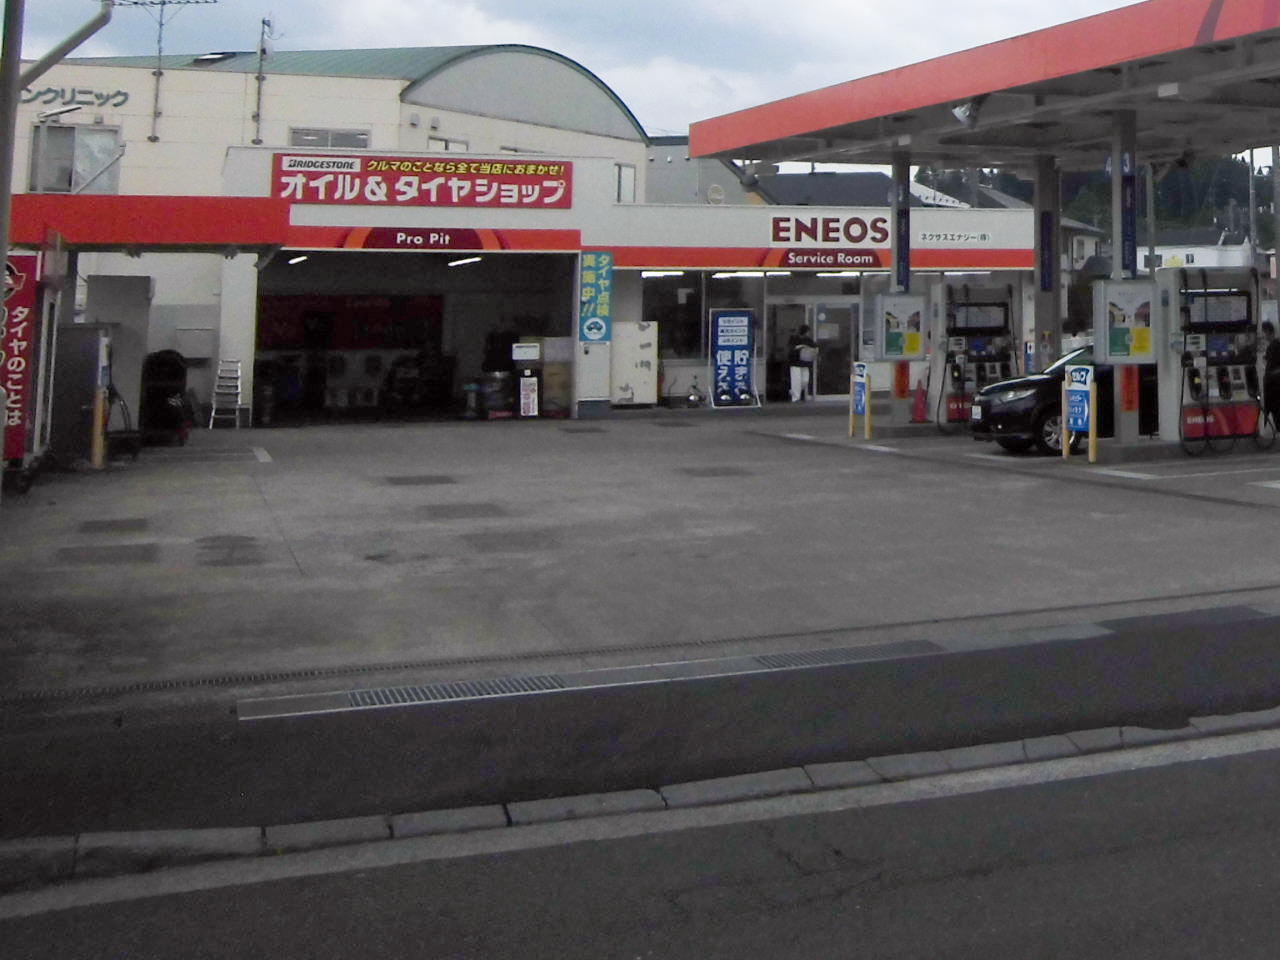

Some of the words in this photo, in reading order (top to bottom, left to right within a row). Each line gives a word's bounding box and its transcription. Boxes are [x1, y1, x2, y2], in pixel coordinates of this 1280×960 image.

[288, 159, 355, 170] BRIDGESTONE
[772, 216, 889, 244] ENEOS
[396, 233, 424, 245] Pro
[430, 232, 451, 245] Pit
[788, 252, 834, 265] Service
[837, 252, 873, 264] Room
[6, 306, 30, 426] タイヤのことは
